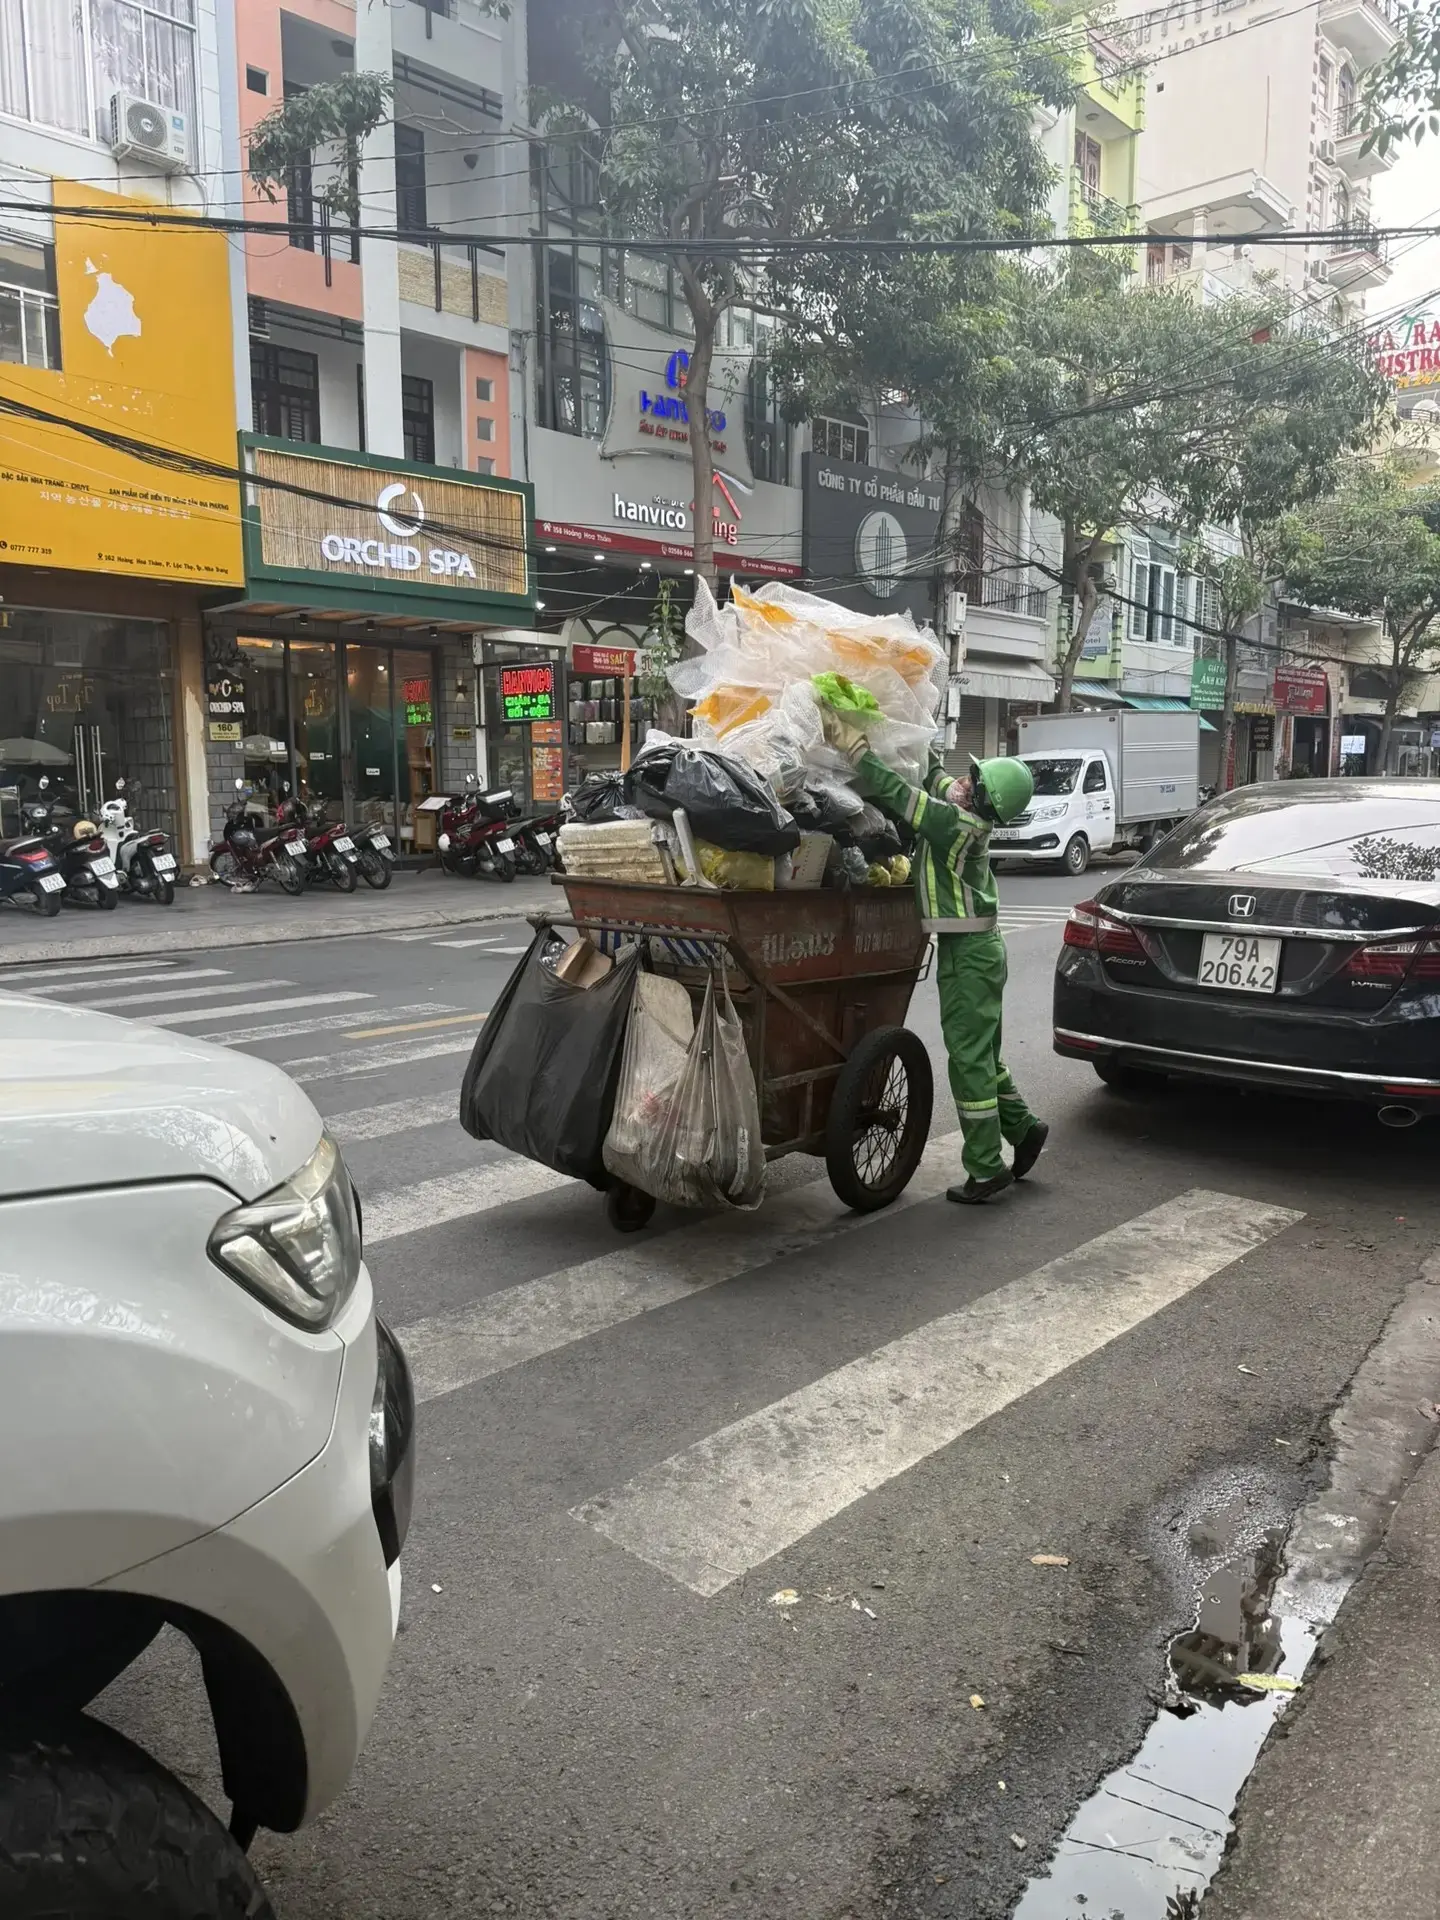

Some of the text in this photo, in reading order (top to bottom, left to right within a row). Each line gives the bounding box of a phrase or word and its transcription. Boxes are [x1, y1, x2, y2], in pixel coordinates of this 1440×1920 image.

[44, 478, 65, 488] TRANG
[818, 468, 845, 491] CÔNG
[848, 477, 861, 494] TY
[864, 475, 878, 498] CỔ
[880, 482, 904, 504] PHẦN
[907, 487, 925, 508] ĐẦU
[614, 493, 686, 529] hanvico
[10, 544, 25, 552] 0777
[584, 532, 596, 541] Hoa
[321, 535, 476, 578] ORCHID SPA
[503, 668, 551, 694] HANVICO
[1105, 955, 1147, 967] Accord
[1220, 937, 1260, 963] 79A
[1201, 961, 1275, 989] 206.42
